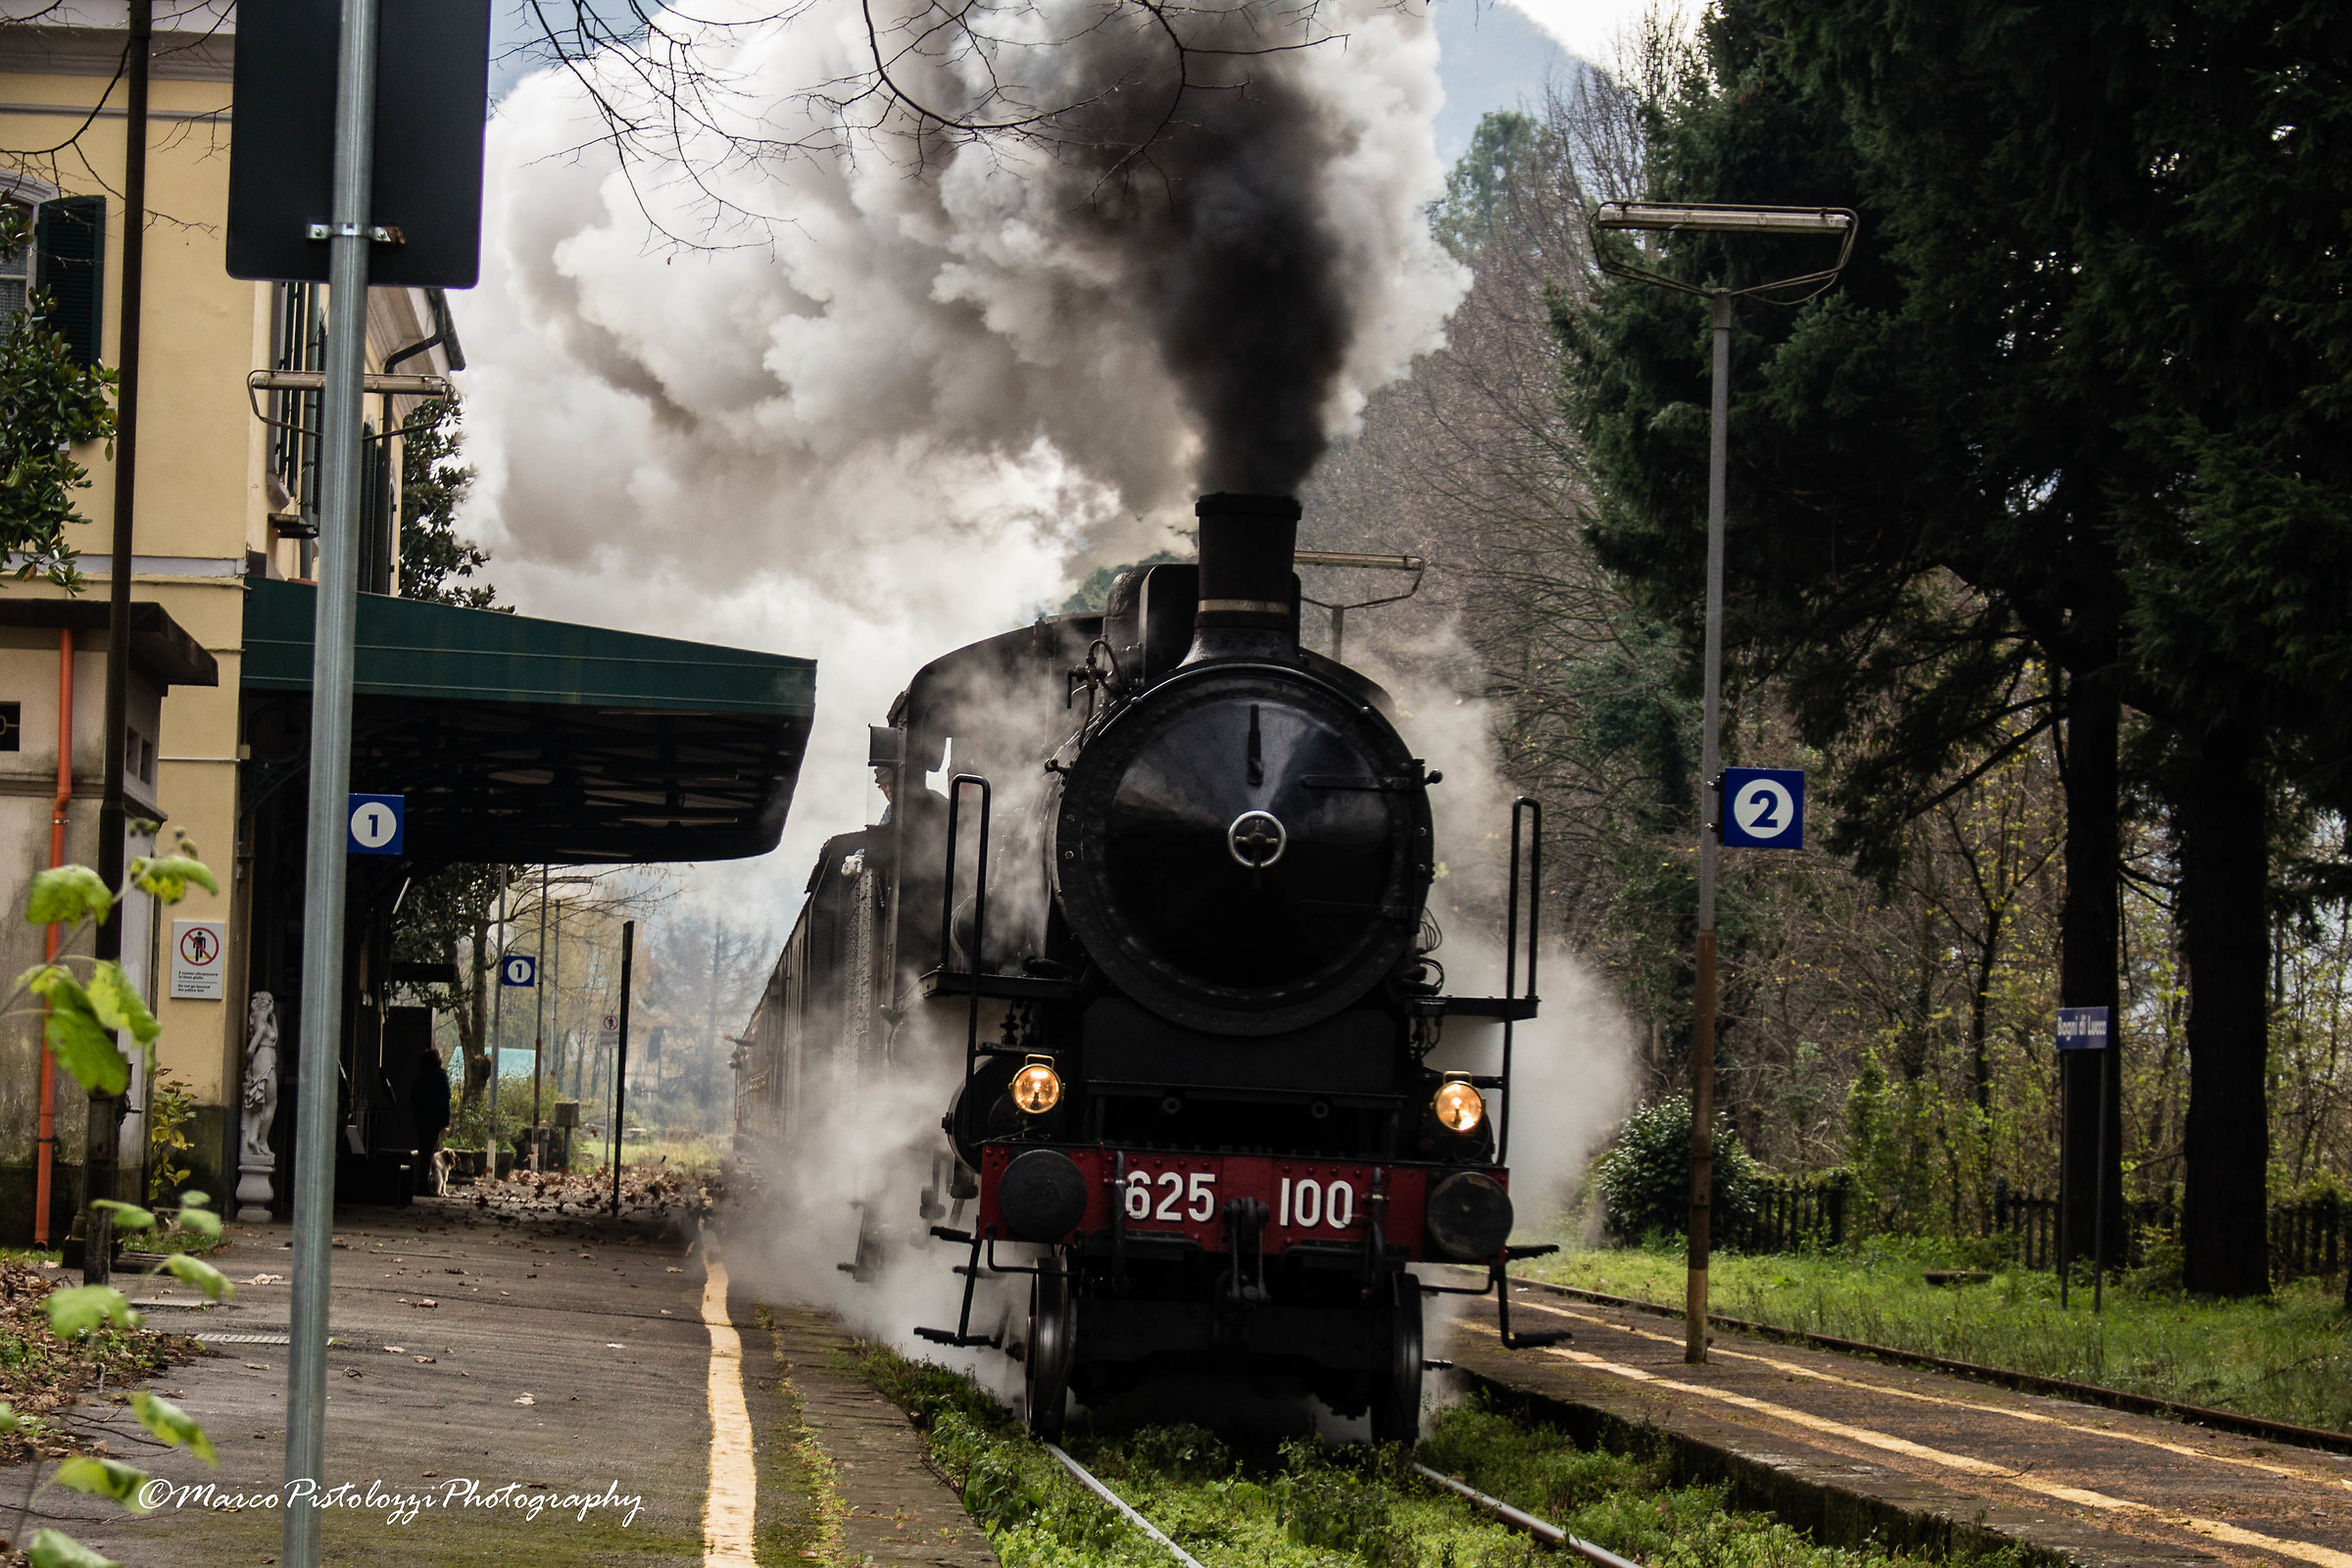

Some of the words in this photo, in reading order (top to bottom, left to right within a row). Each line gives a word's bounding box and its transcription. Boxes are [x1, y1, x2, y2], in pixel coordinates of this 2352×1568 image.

[1748, 789, 1779, 829] 2
[368, 813, 379, 838] 1
[515, 963, 523, 979] 1
[1125, 1170, 1216, 1222] 625
[1279, 1177, 1354, 1229] 100
